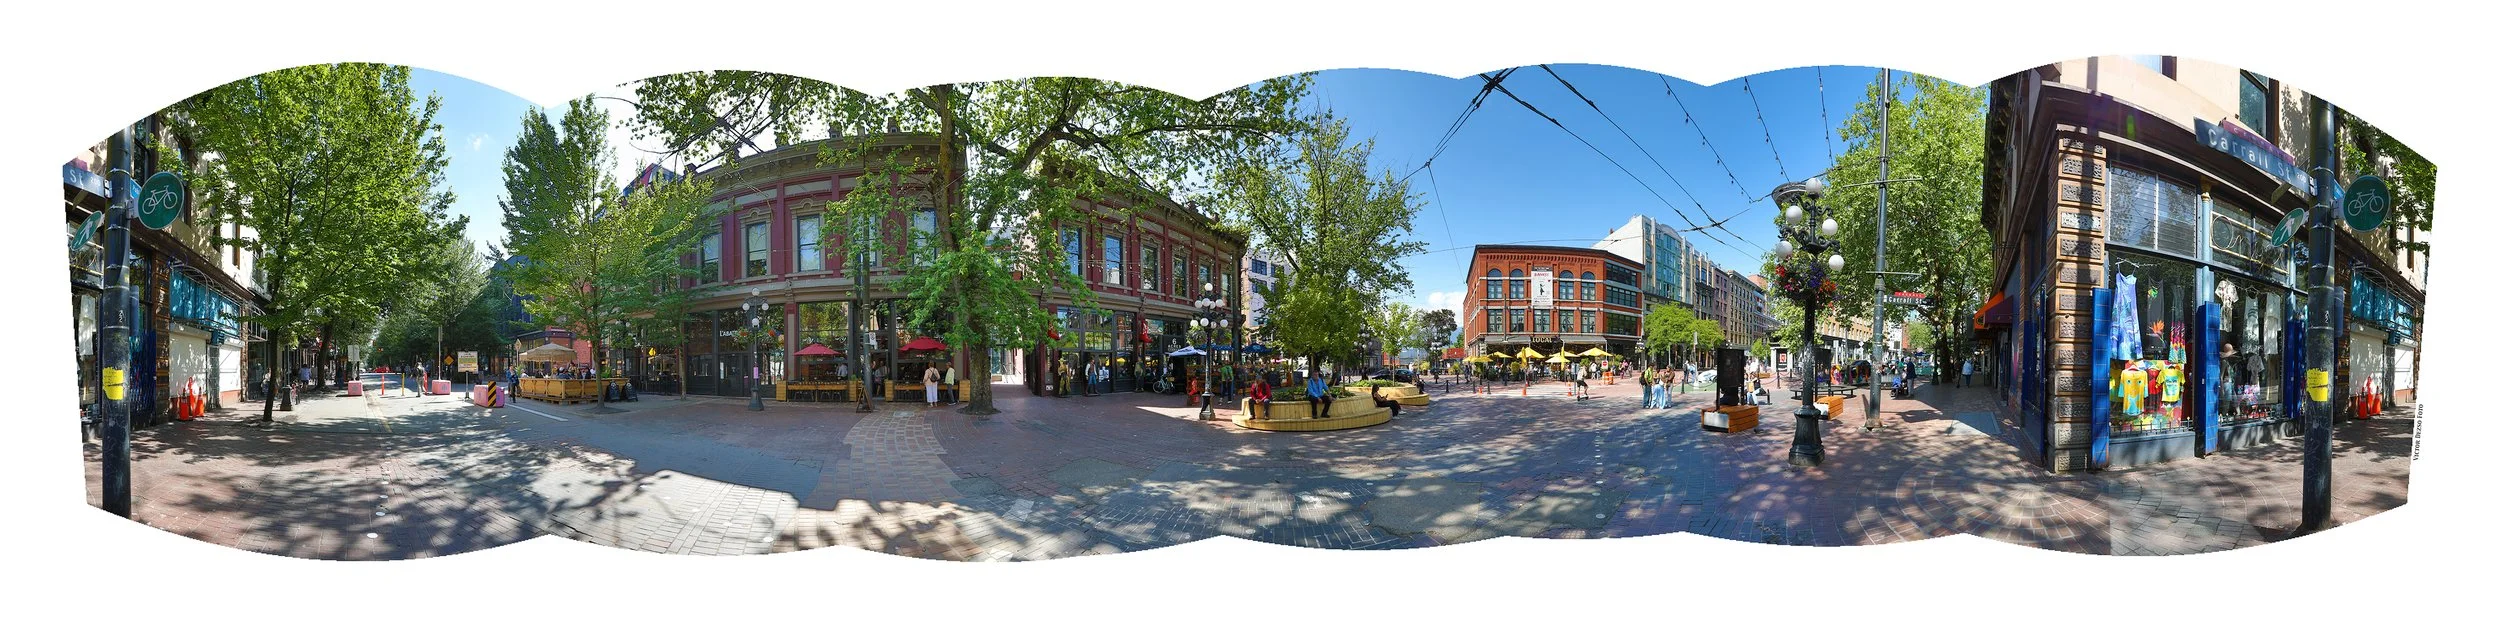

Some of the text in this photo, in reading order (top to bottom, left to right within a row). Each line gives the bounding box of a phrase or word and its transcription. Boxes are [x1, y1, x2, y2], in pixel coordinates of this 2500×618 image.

[2208, 127, 2269, 169] Carrall
[2278, 163, 2292, 182] St
[1888, 296, 1912, 304] Carrall
[1172, 337, 1177, 345] 6
